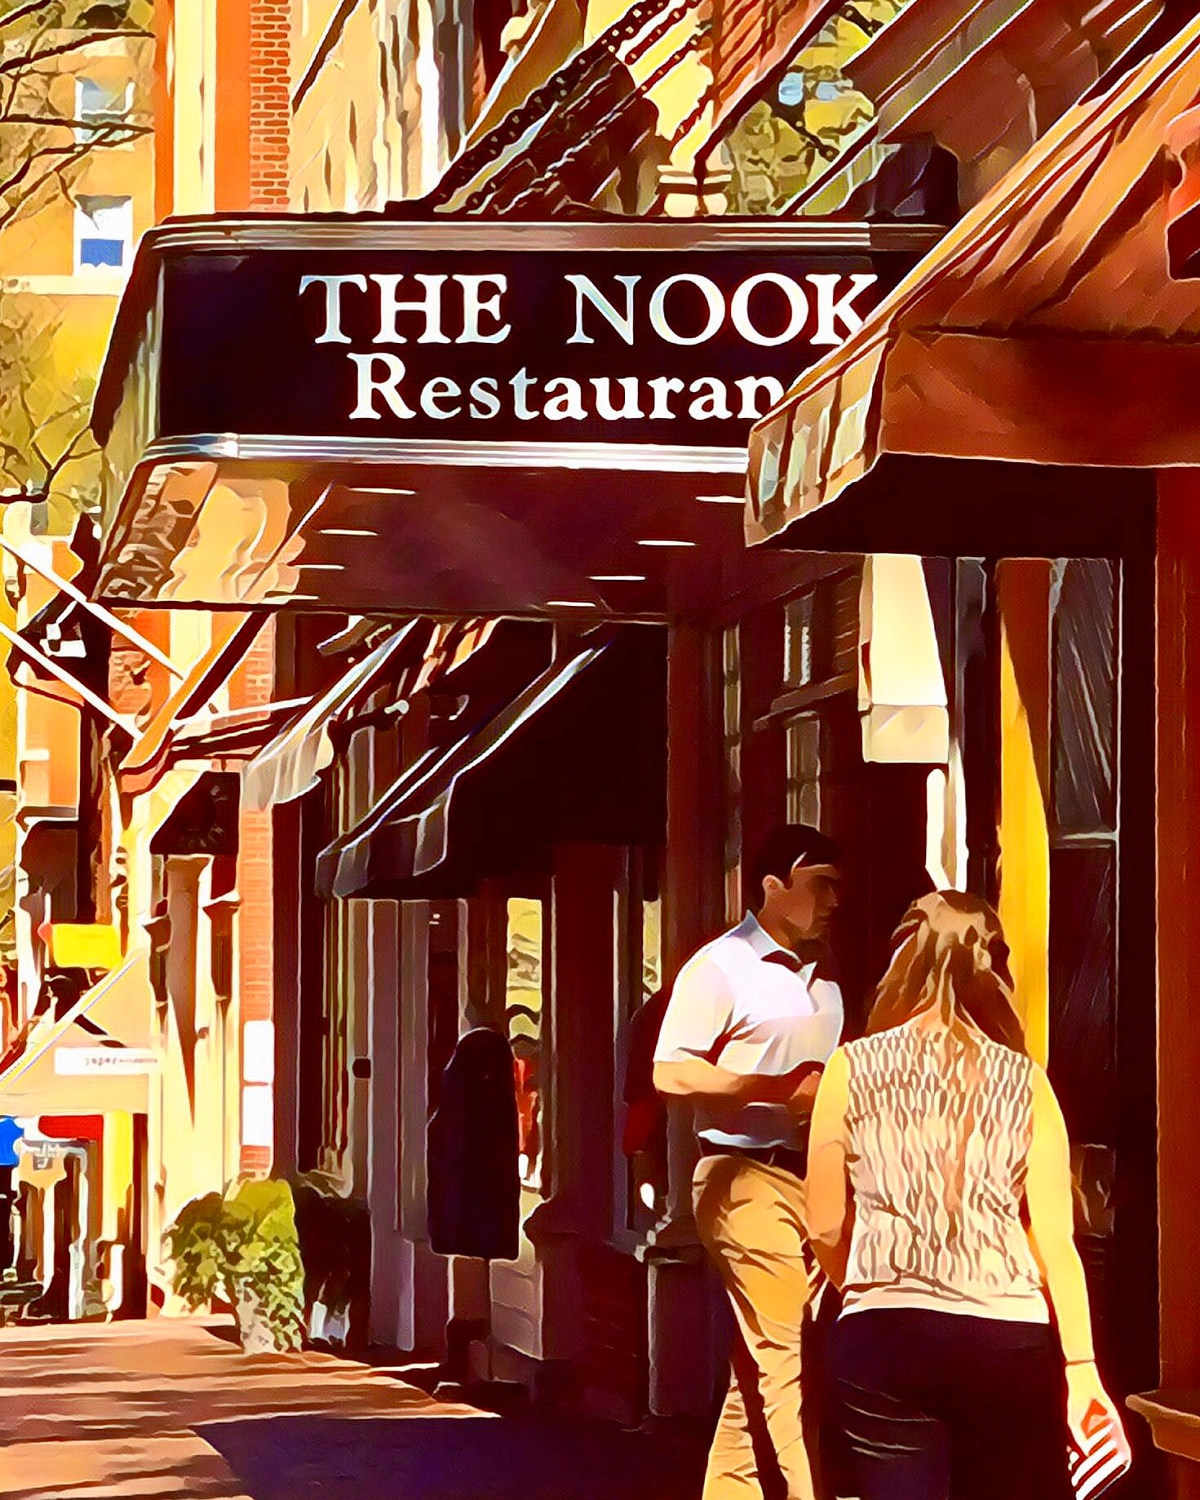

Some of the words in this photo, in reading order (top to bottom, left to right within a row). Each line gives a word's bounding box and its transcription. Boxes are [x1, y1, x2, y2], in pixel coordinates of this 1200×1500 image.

[298, 273, 512, 345] THE
[564, 272, 879, 347] NOOK
[346, 352, 786, 421] Restauran
